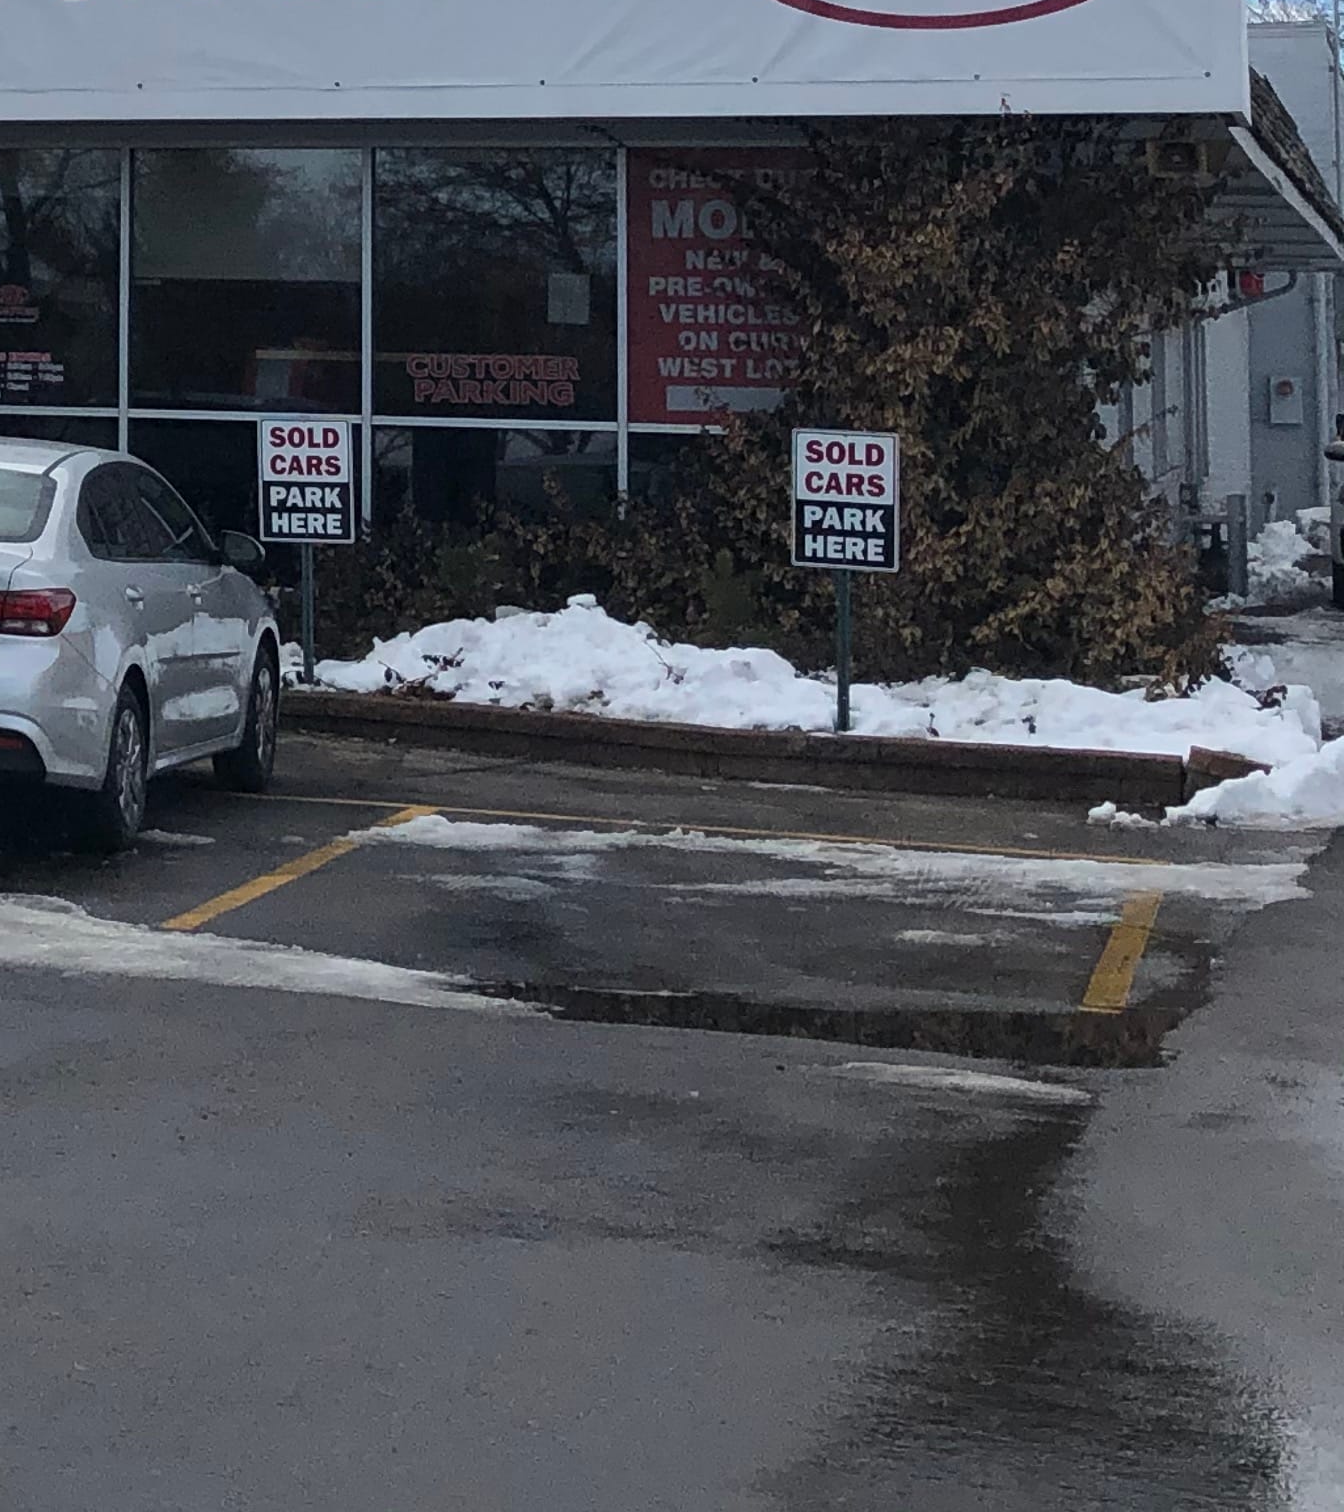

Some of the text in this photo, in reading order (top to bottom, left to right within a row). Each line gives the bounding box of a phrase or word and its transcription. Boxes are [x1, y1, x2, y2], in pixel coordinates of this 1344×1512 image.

[659, 303, 801, 325] VEHICLES
[678, 330, 719, 351] ON
[406, 353, 581, 381] CUSTOMER
[657, 357, 737, 379] WEST
[414, 379, 574, 406] PARKING
[269, 426, 340, 449] SOLD
[269, 454, 342, 476] CARS
[805, 439, 885, 467] SOLD
[804, 471, 886, 497] CARS
[269, 485, 343, 508] PARK
[271, 511, 343, 535] HERE
[803, 505, 886, 533] PARK
[804, 534, 885, 563] HERE
